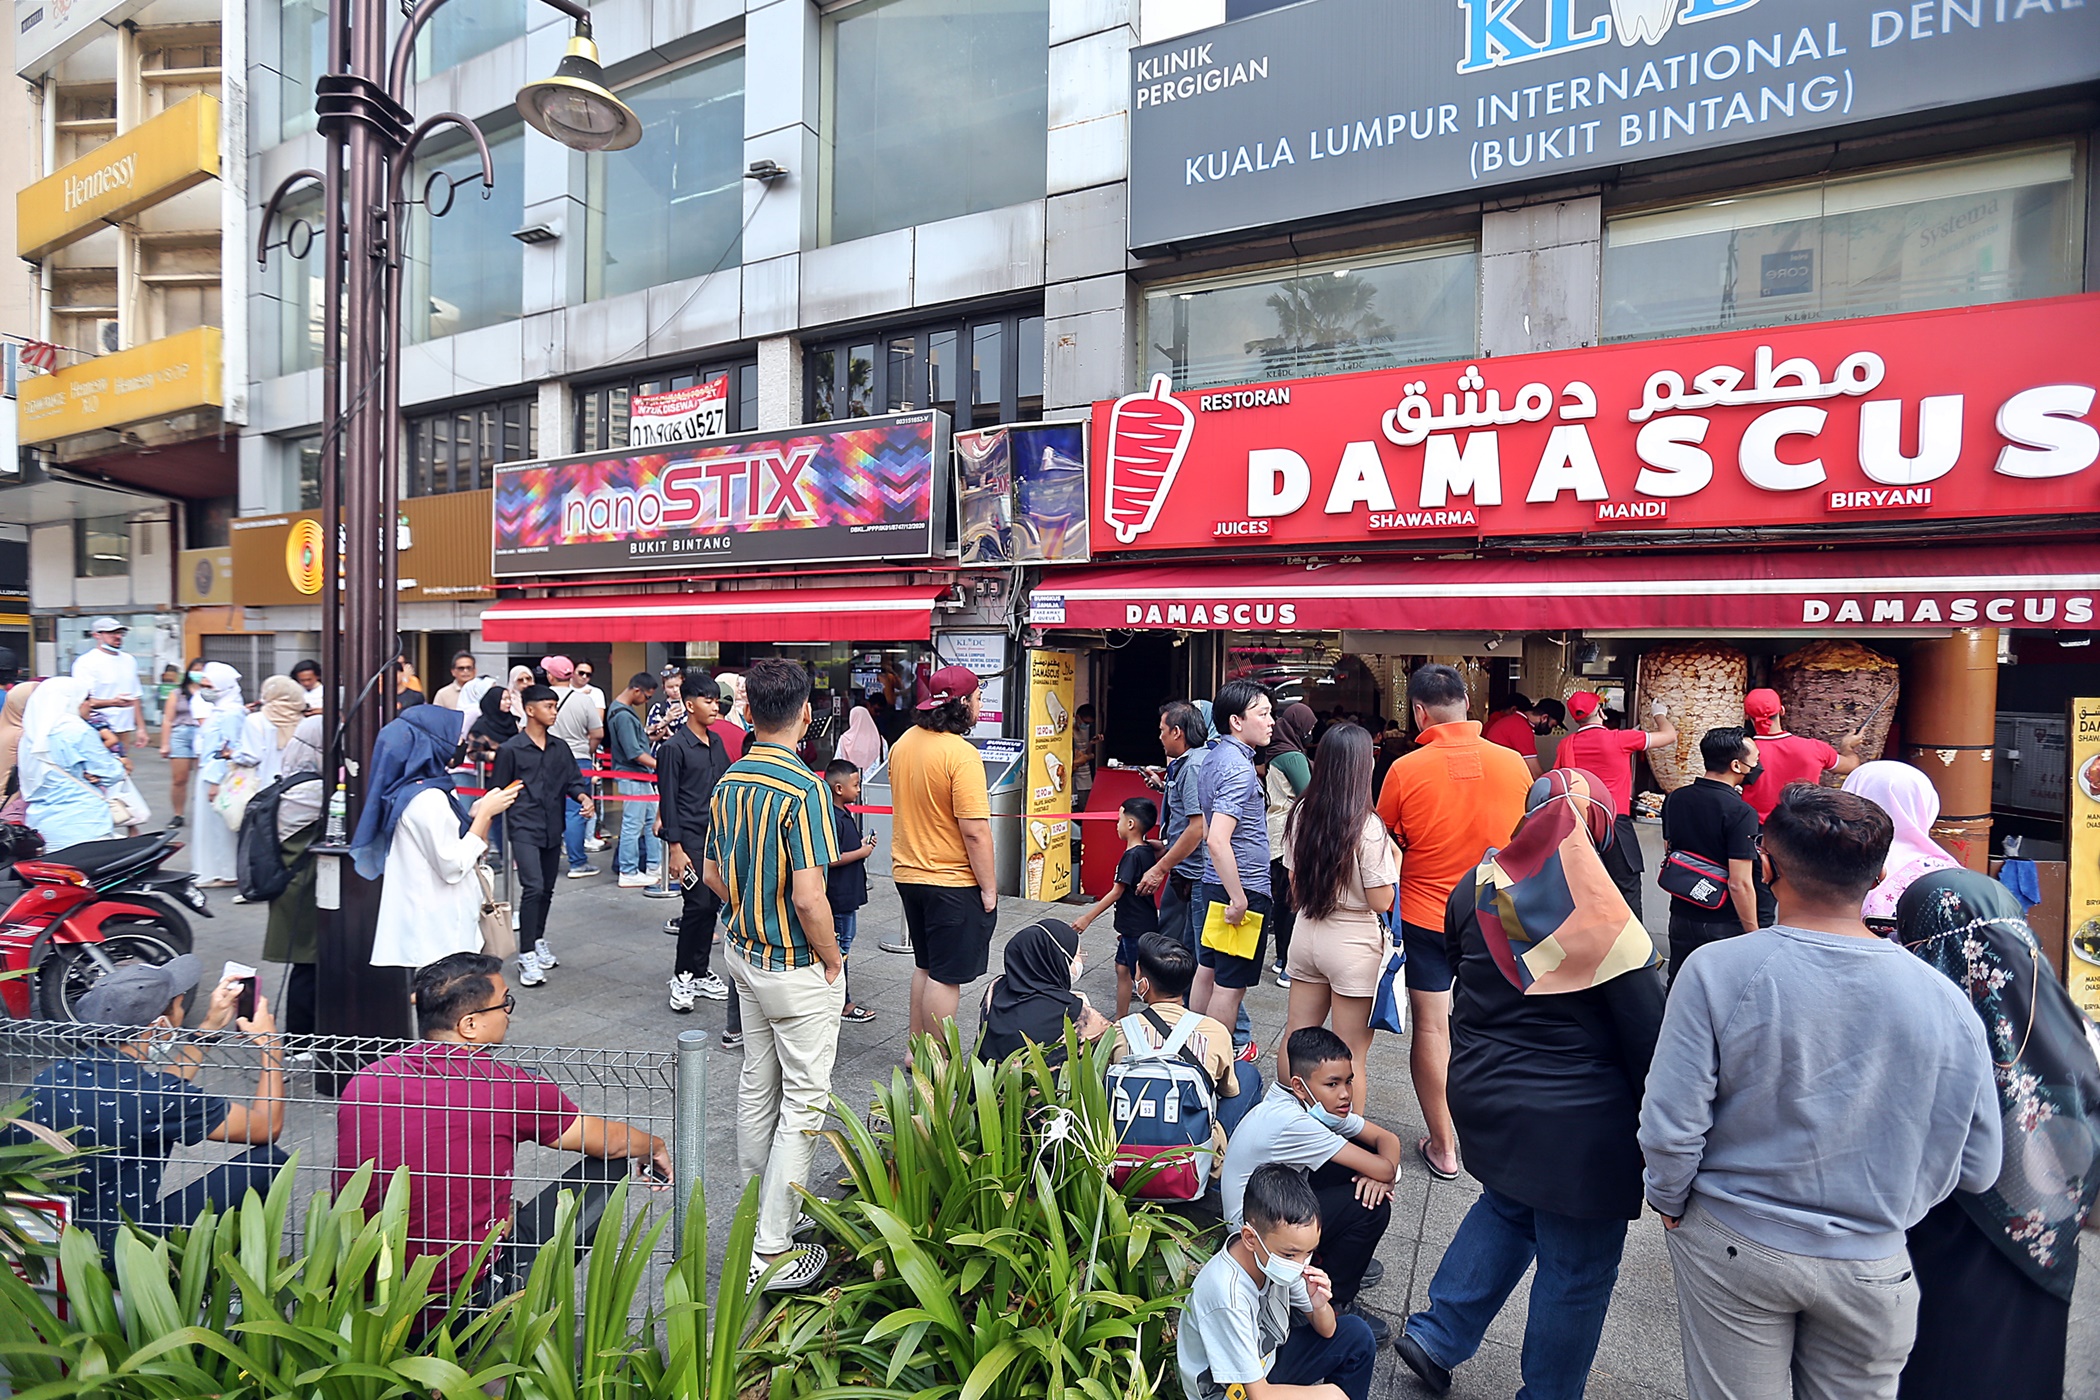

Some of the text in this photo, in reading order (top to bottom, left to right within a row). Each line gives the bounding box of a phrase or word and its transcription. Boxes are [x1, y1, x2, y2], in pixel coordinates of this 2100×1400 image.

[1136, 57, 1269, 109] PERGIGIAN
[1137, 43, 1214, 82] KLINIK
[1185, 136, 1295, 186] KUALA
[1309, 104, 1459, 161] LUMPUR
[1475, 22, 1848, 128] INTERNATIONAL
[1469, 69, 1855, 180] (BUKIT BINTANG)
[63, 152, 137, 212] Hennessy
[1918, 197, 2000, 249] Systema
[1199, 386, 1291, 413] RESTORAN
[1381, 345, 1886, 447] مطعم دمشق
[1246, 384, 2100, 517] DAMASCUS
[1212, 487, 1933, 536] JUICES SHAWARMA MANDI BIRYANI
[629, 536, 731, 554] BUKIT BINTANG
[1125, 603, 1297, 625] DAMASCUS
[1802, 597, 2093, 624] DAMASCUS
[1033, 668, 1060, 678] DAMASCUS
